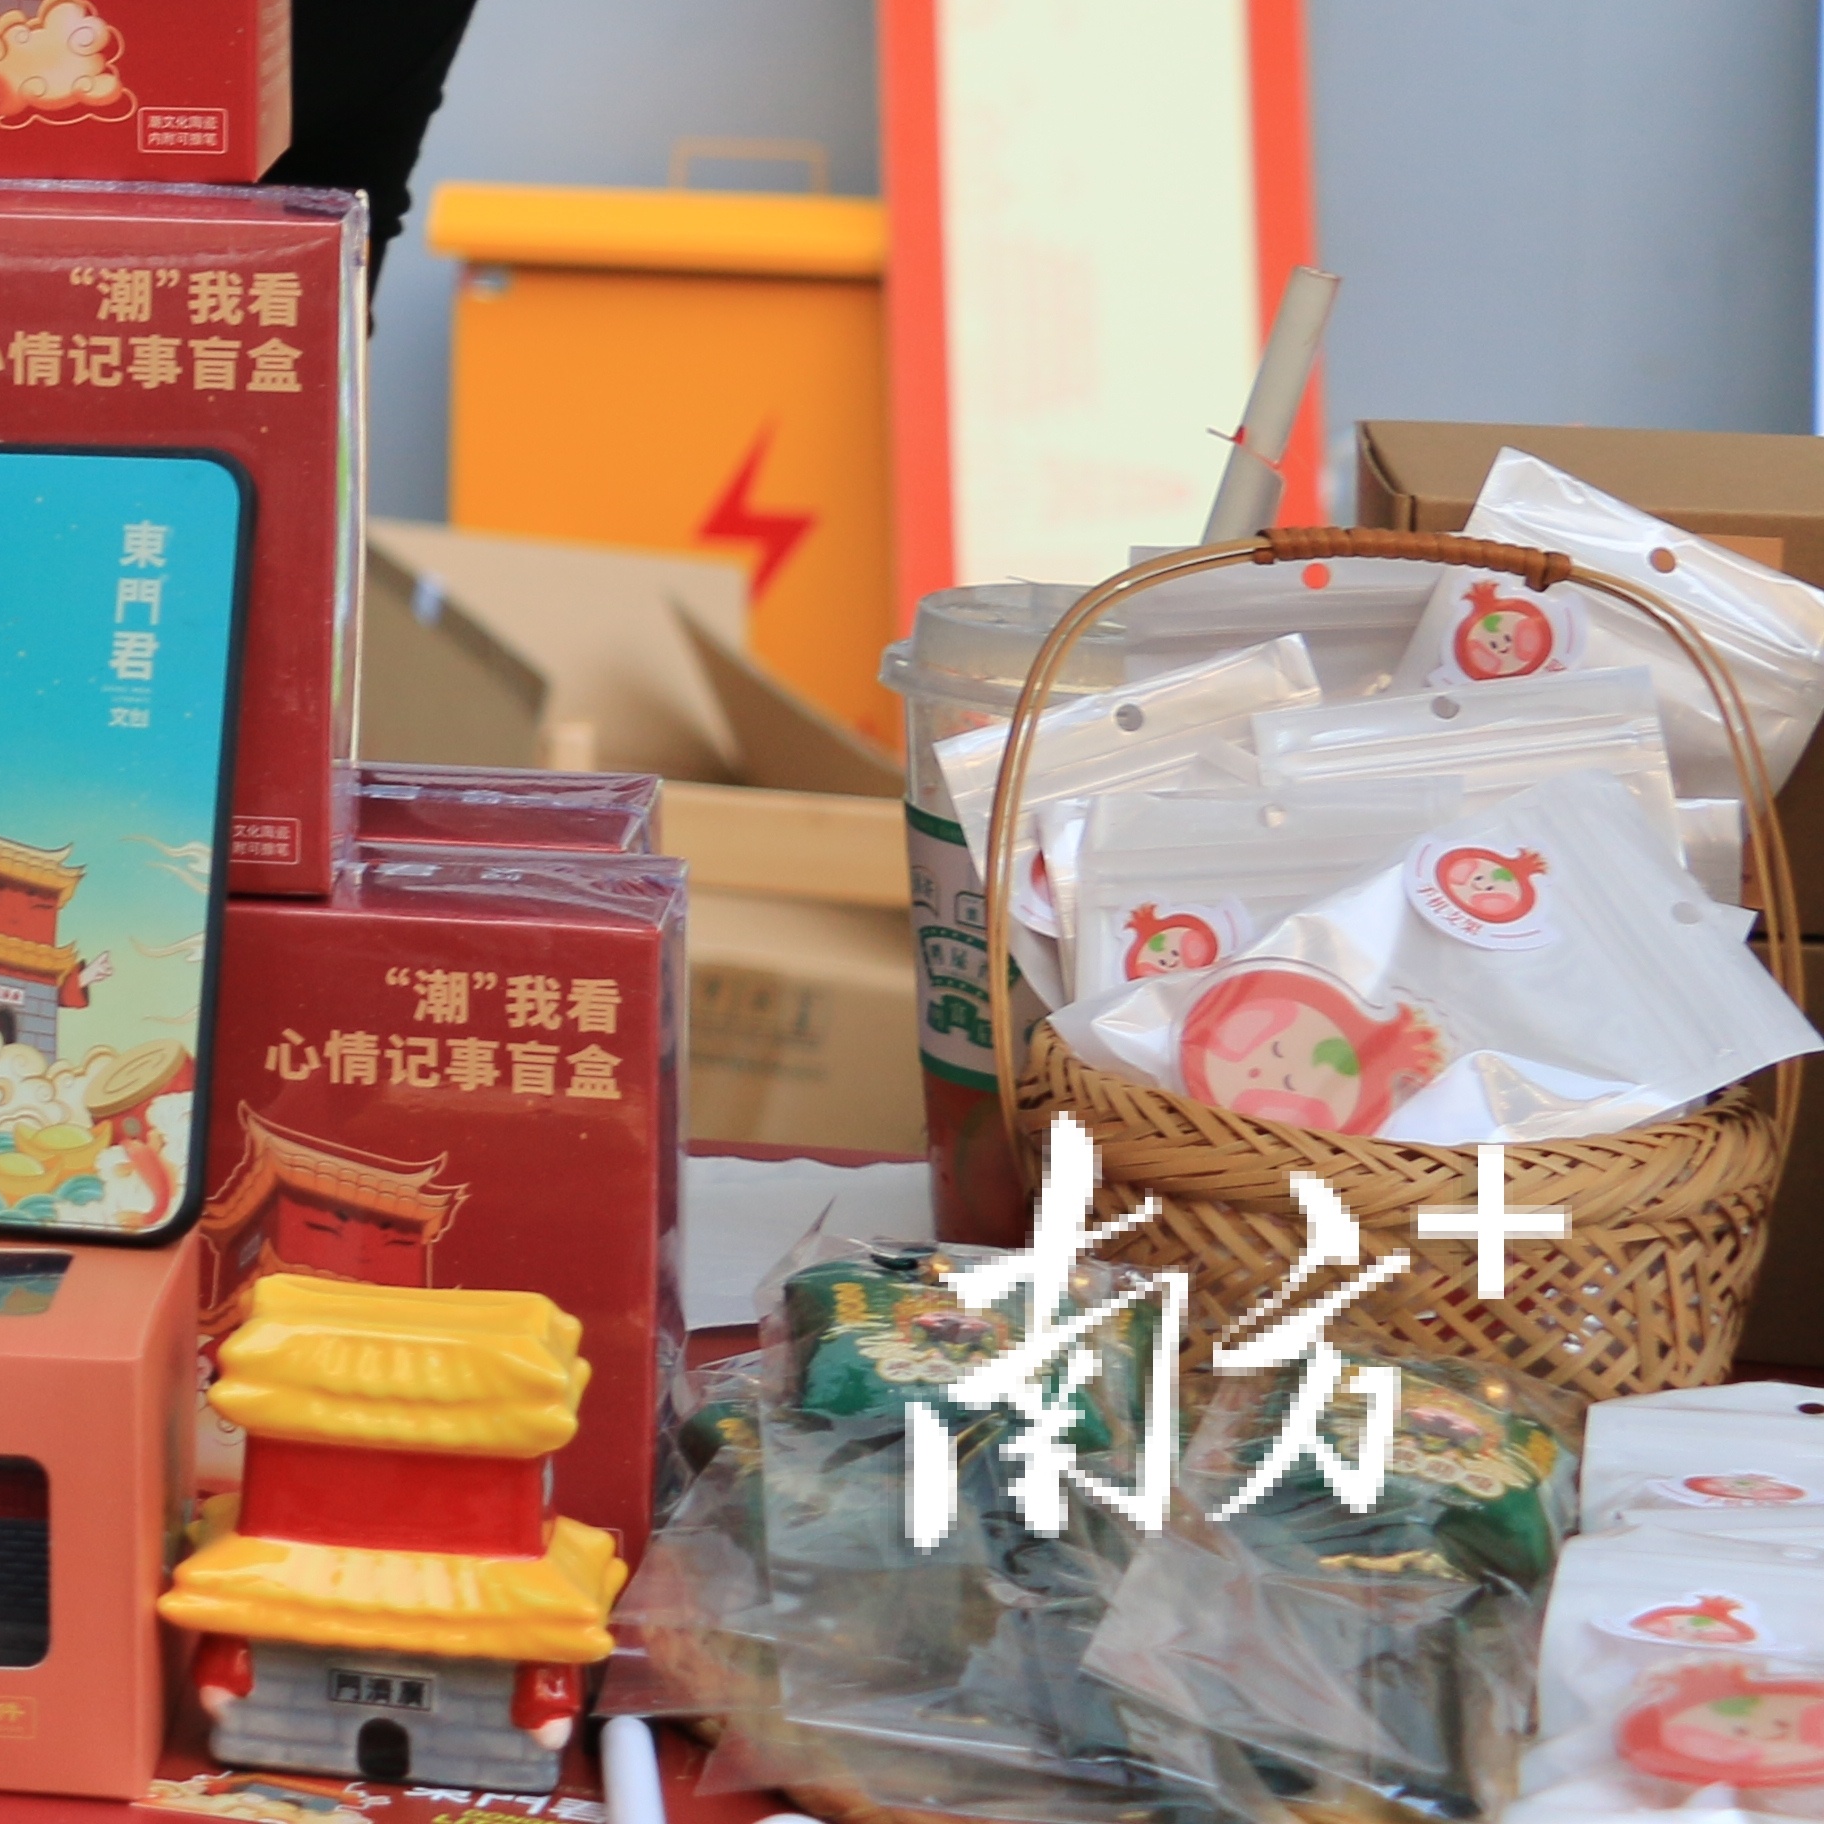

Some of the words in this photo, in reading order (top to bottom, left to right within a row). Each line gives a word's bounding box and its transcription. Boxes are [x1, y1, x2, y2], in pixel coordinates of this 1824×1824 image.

[68, 266, 303, 327] “潮”我看
[108, 519, 170, 681] 東門君
[385, 966, 623, 1034] “潮”我看
[264, 1027, 623, 1100] 心情记事盲盒
